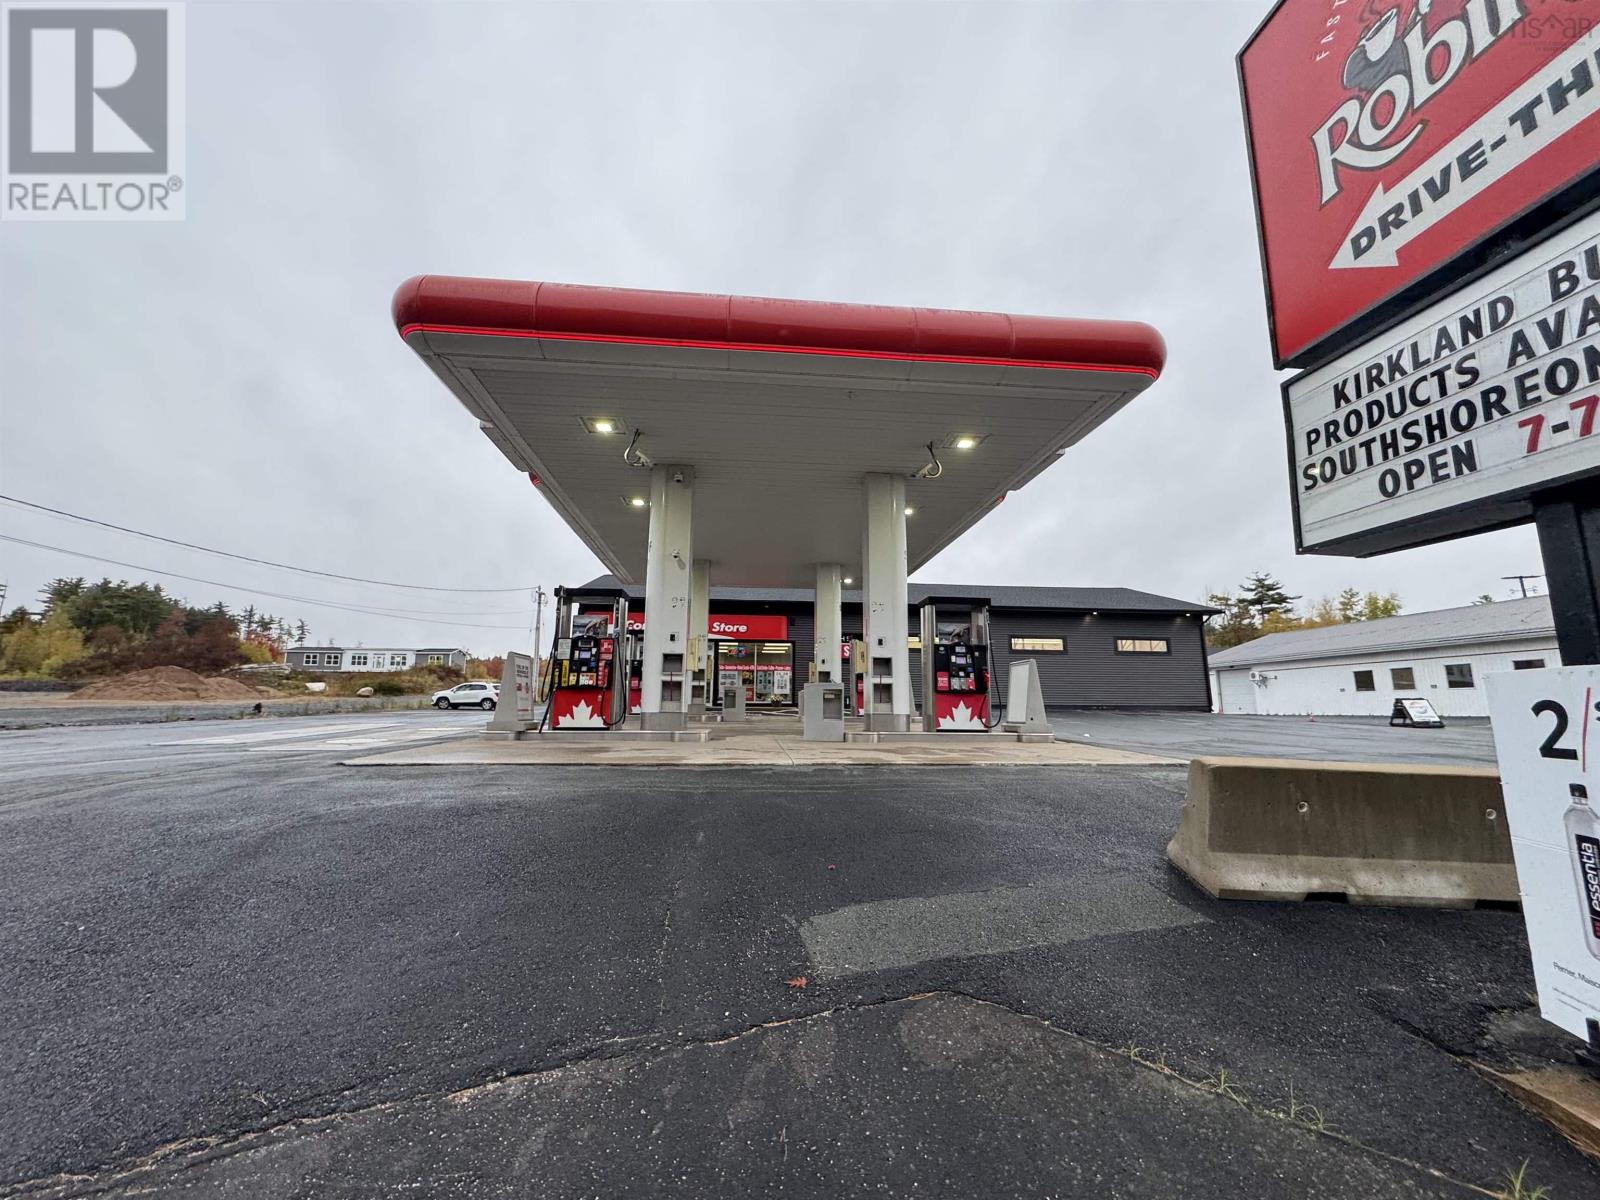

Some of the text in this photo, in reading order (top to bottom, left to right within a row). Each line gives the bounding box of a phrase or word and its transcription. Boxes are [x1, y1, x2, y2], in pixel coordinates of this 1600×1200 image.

[1350, 46, 1600, 260] DRIVE-TH
[1305, 352, 1480, 455] PRODUCTS
[1332, 295, 1515, 409] KIRKLAND
[1378, 439, 1478, 498] OPEN
[712, 622, 748, 632] Store
